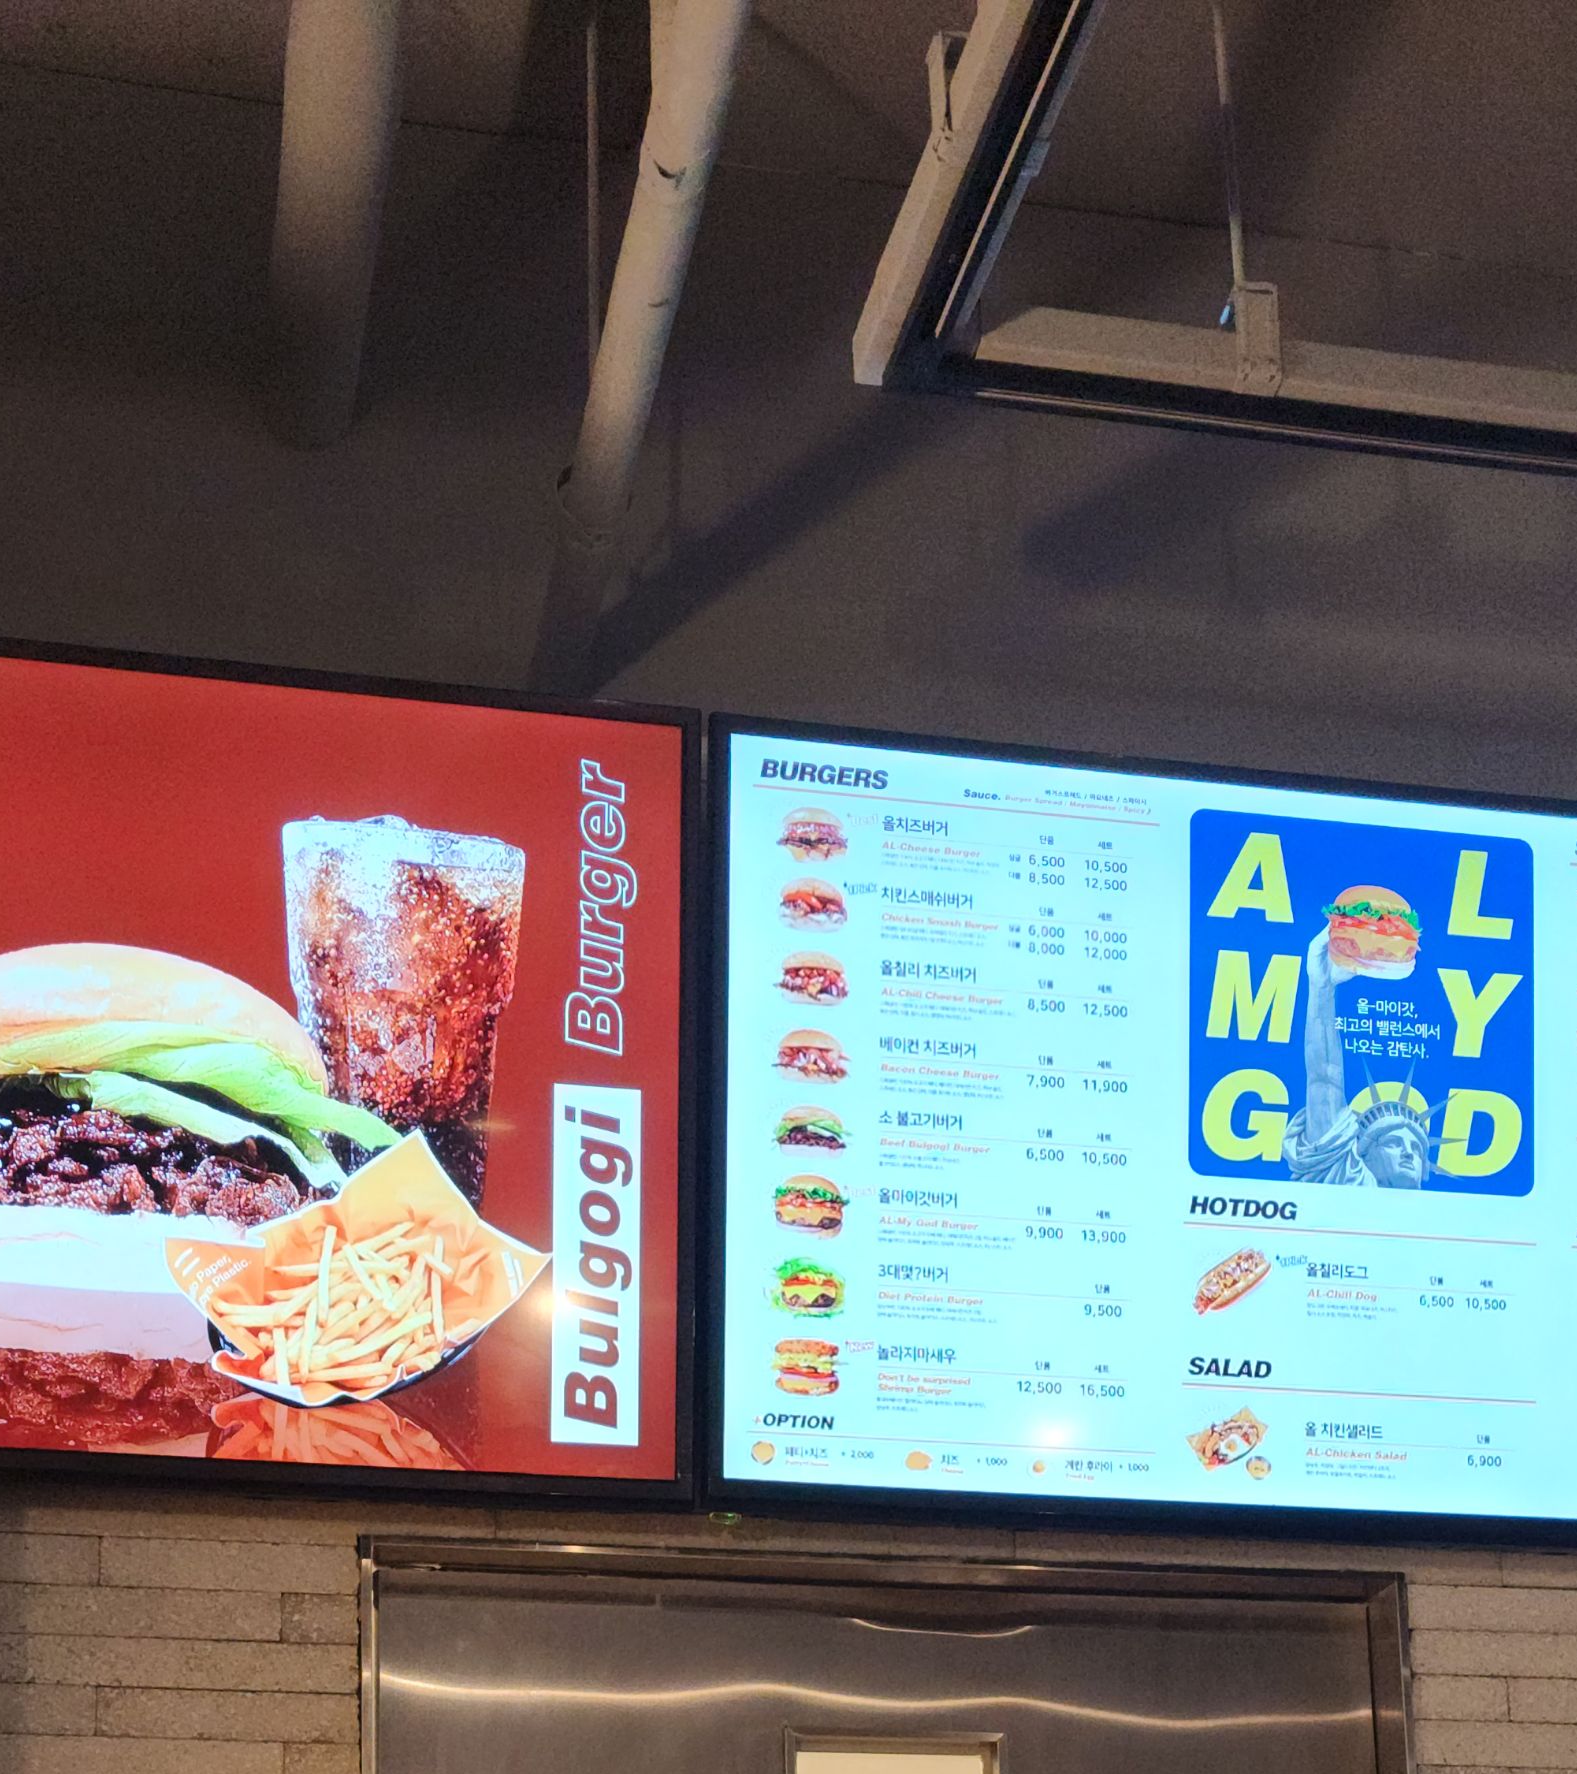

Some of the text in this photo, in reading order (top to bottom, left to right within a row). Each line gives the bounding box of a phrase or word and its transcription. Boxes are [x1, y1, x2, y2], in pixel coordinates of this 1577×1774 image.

[760, 758, 889, 789] BURGERS
[882, 816, 949, 836] 올치즈버거
[1028, 854, 1128, 874] 6,500 10,500
[1028, 872, 1128, 892] 8,500 12,500
[564, 757, 638, 1057] Burger
[881, 887, 973, 910] 치킨스매쉬버거
[1028, 925, 1128, 944] 6,000 10,000
[1028, 942, 1128, 962] 8,000 12,000
[924, 964, 977, 983] 치즈버거
[1027, 999, 1066, 1013] 8,500
[1083, 1003, 1128, 1018] 12,500
[1334, 1016, 1441, 1040] 최고의 밸런스에서
[879, 1037, 977, 1060] 베이컨 치즈버거
[1345, 1037, 1429, 1059] 나오는 감탄사.
[1027, 1074, 1128, 1094] 7,900 11,900
[896, 1110, 963, 1131] 불고기버거
[1026, 1148, 1127, 1167] 6,500 10,500
[1189, 1196, 1298, 1221] HOTDOG
[1025, 1225, 1064, 1240] 9,900
[1081, 1229, 1126, 1244] 13,900
[564, 1104, 634, 1431] Bulgogi
[878, 1263, 949, 1283] 3대몇?버거
[1083, 1303, 1123, 1319] 9,500
[1419, 1295, 1507, 1312] 6,500 10,500
[877, 1344, 956, 1365] 놀라지마새우
[1187, 1356, 1273, 1379] SALAD
[1017, 1380, 1125, 1399] 12,500 16,500
[1321, 1422, 1383, 1440] 치킨샐러드
[1467, 1454, 1502, 1468] 6,900
